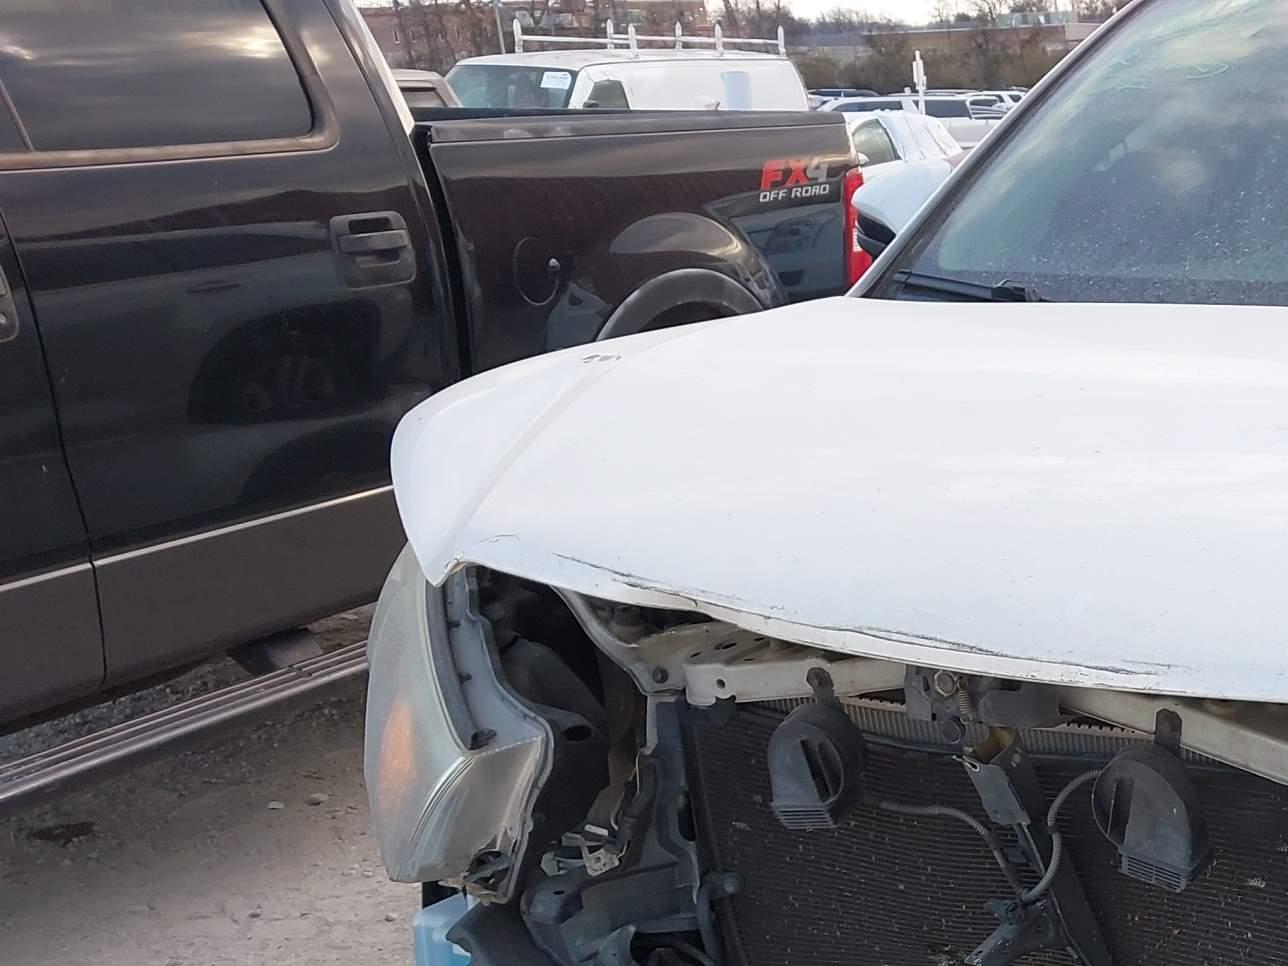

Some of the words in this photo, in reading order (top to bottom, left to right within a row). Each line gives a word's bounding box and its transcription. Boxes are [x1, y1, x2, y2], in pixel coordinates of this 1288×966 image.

[760, 157, 829, 190] FX4
[759, 189, 787, 203] OFF
[791, 183, 830, 199] ROAD
